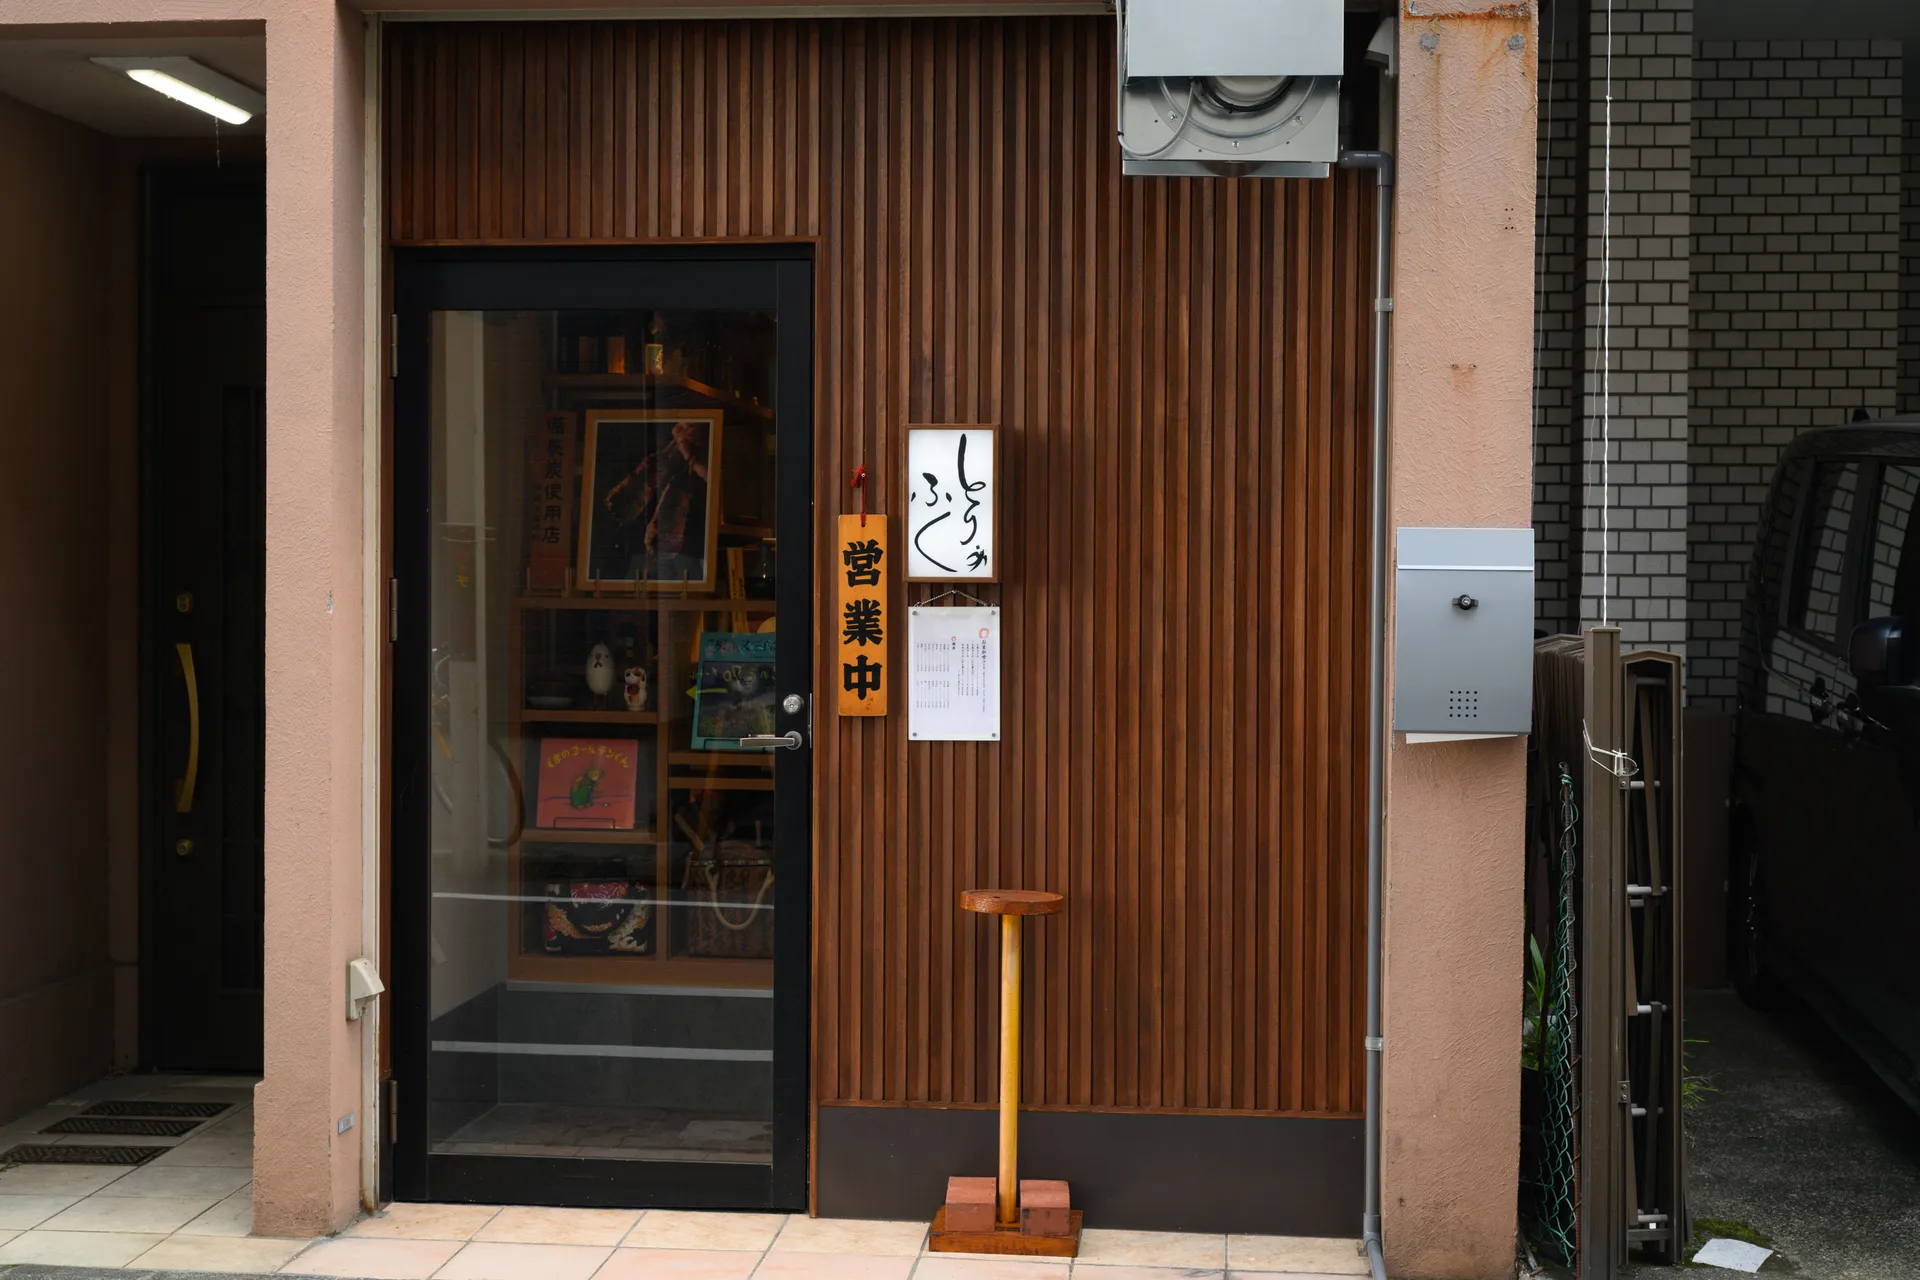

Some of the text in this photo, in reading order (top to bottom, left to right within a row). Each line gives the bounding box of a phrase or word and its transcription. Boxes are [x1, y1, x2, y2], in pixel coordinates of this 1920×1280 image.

[842, 539, 884, 700] 営業中
[547, 745, 629, 768] くまのコールテンくん
